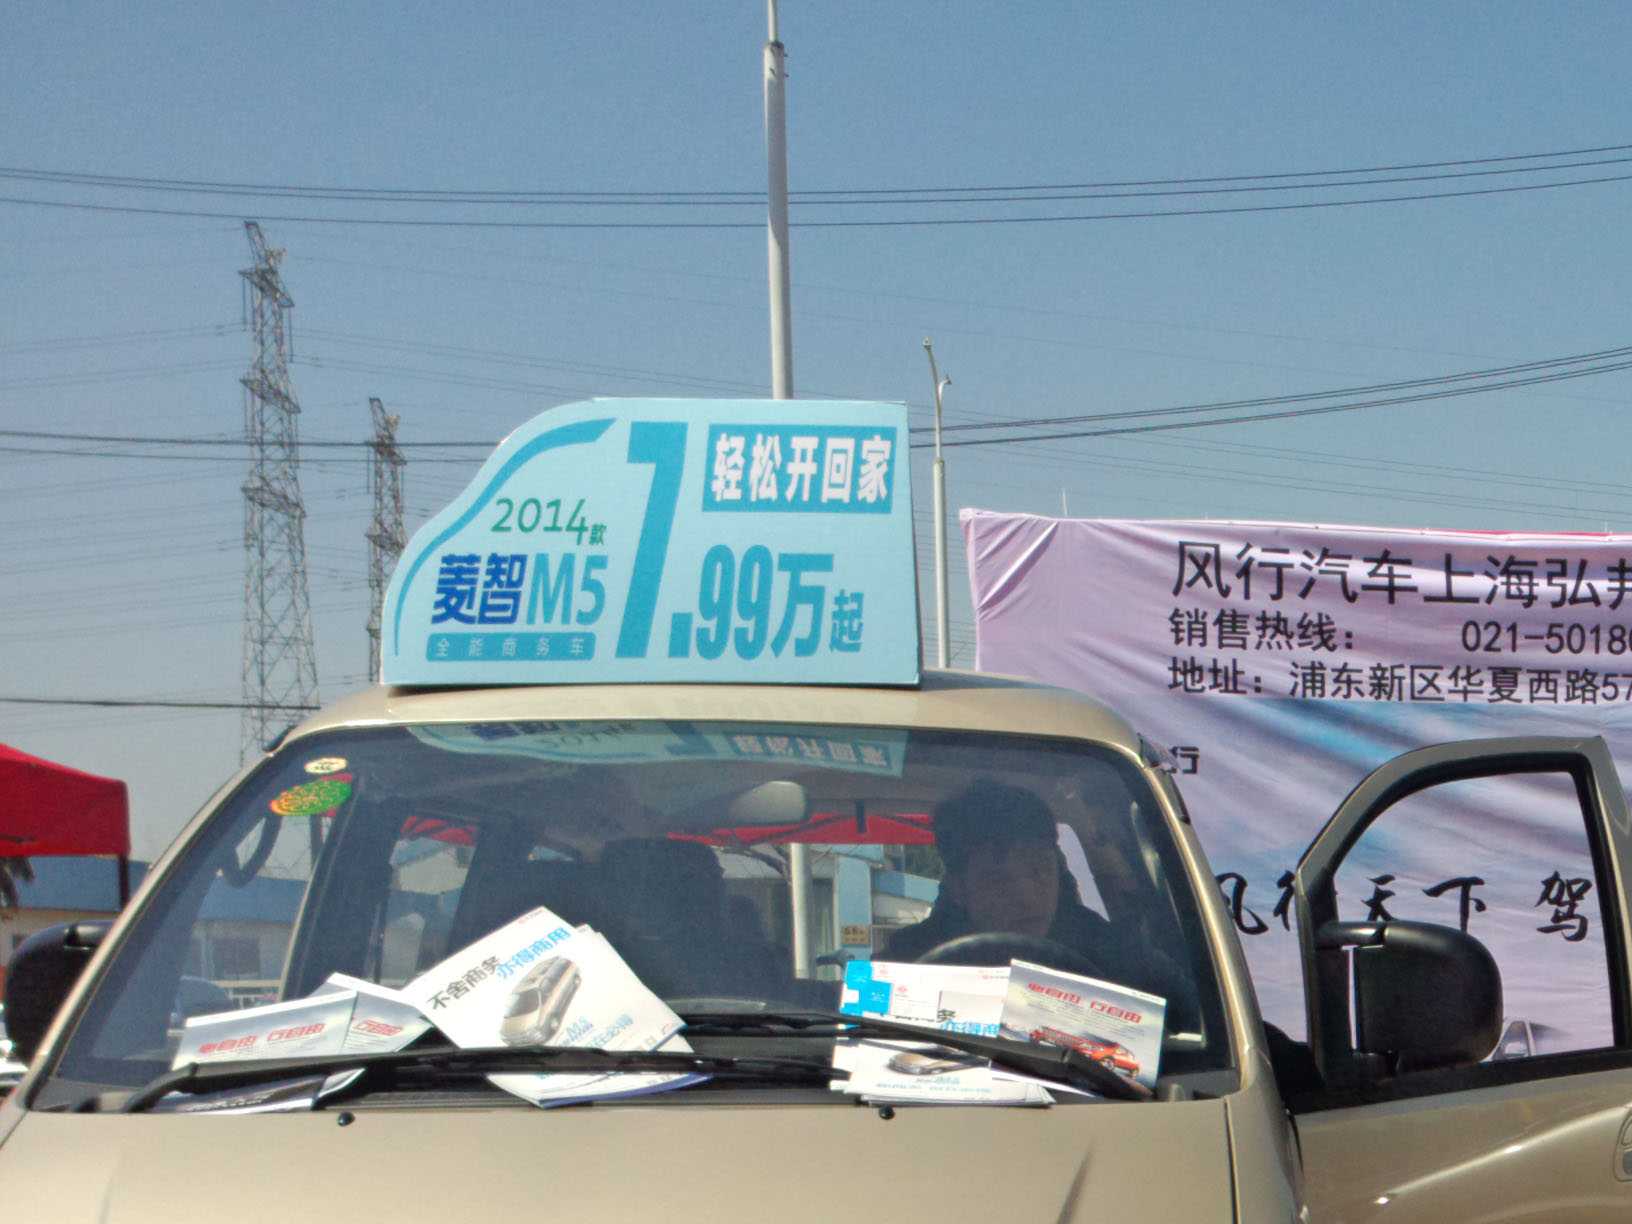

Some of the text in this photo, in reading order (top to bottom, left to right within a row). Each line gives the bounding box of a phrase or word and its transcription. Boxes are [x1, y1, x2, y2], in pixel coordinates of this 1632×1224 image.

[710, 432, 893, 504] 轻松开回家
[490, 498, 608, 547] 2014款
[431, 552, 610, 626] 菱智M5
[1168, 610, 1358, 655] 销售热线：
[496, 926, 572, 980] 亦得商用
[425, 955, 501, 1010] 不舍商务
